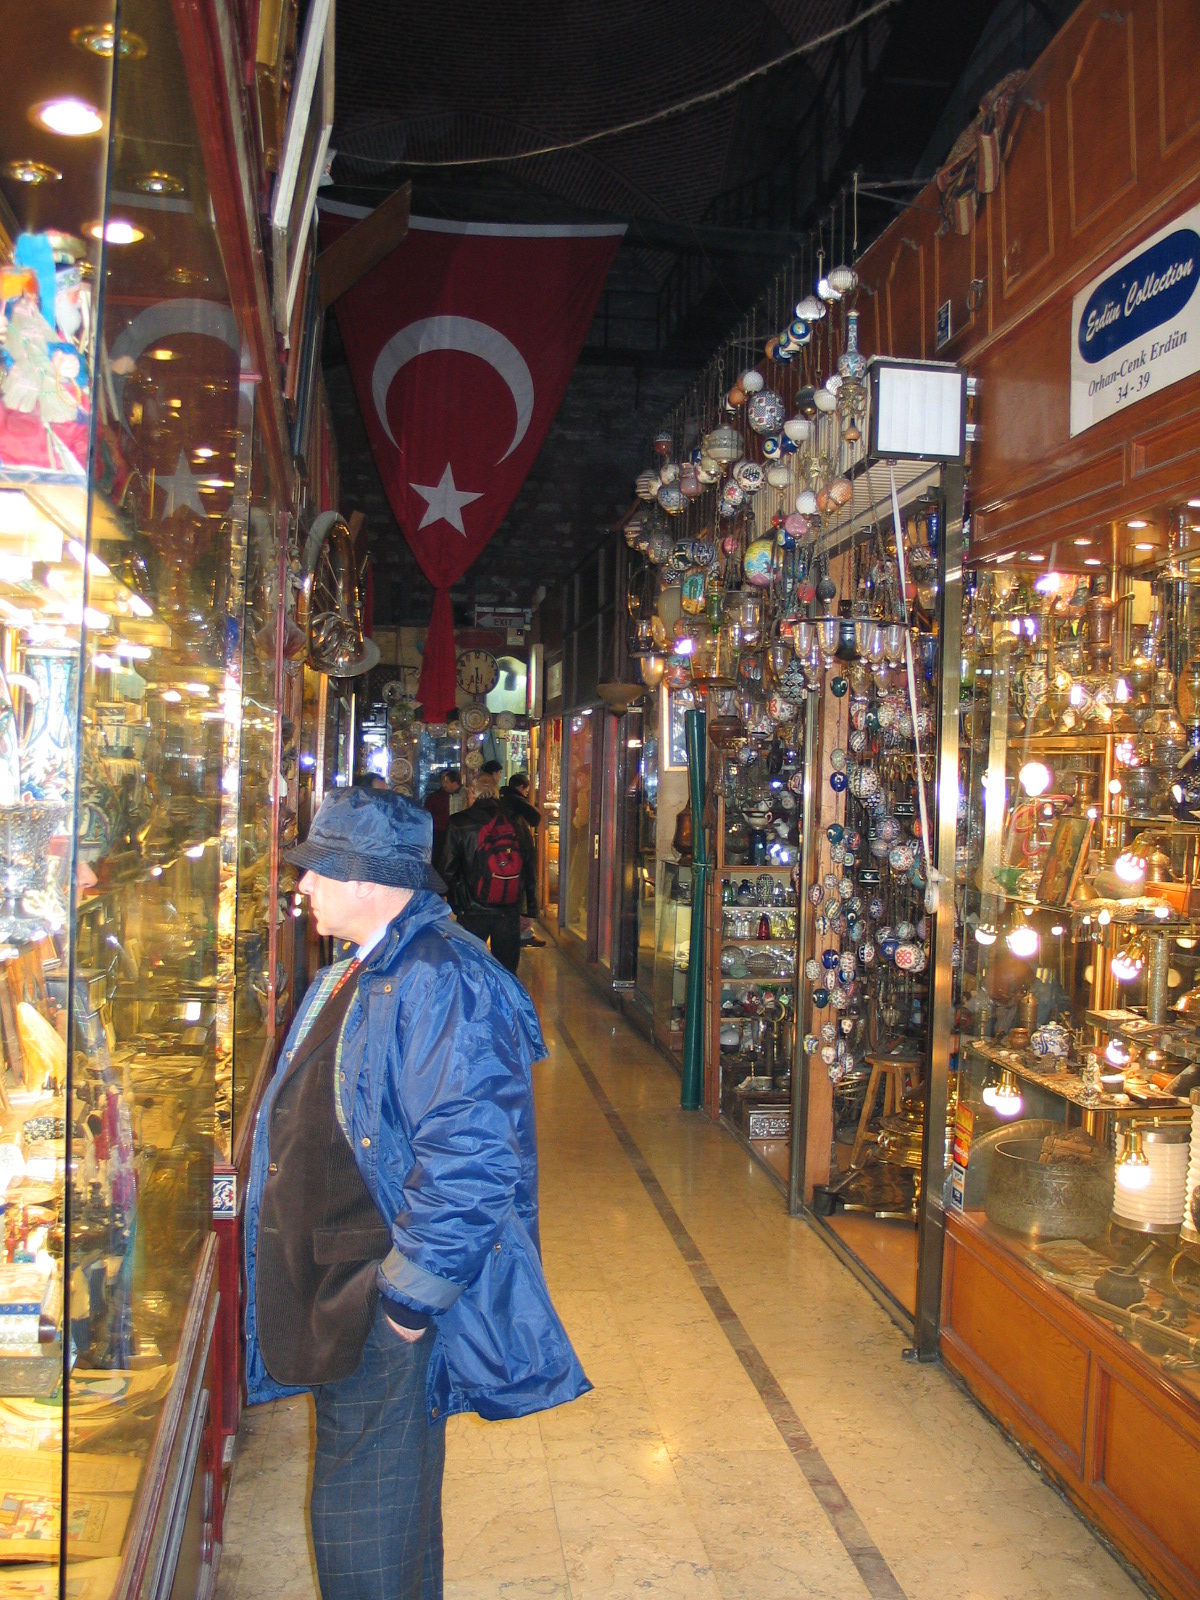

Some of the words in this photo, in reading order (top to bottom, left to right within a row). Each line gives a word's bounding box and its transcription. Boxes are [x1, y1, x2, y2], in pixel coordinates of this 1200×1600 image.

[1124, 258, 1194, 317] Collection
[1088, 349, 1147, 397] Orhan-Cenk
[1150, 330, 1187, 361] Erdün
[494, 618, 513, 627] EXIT
